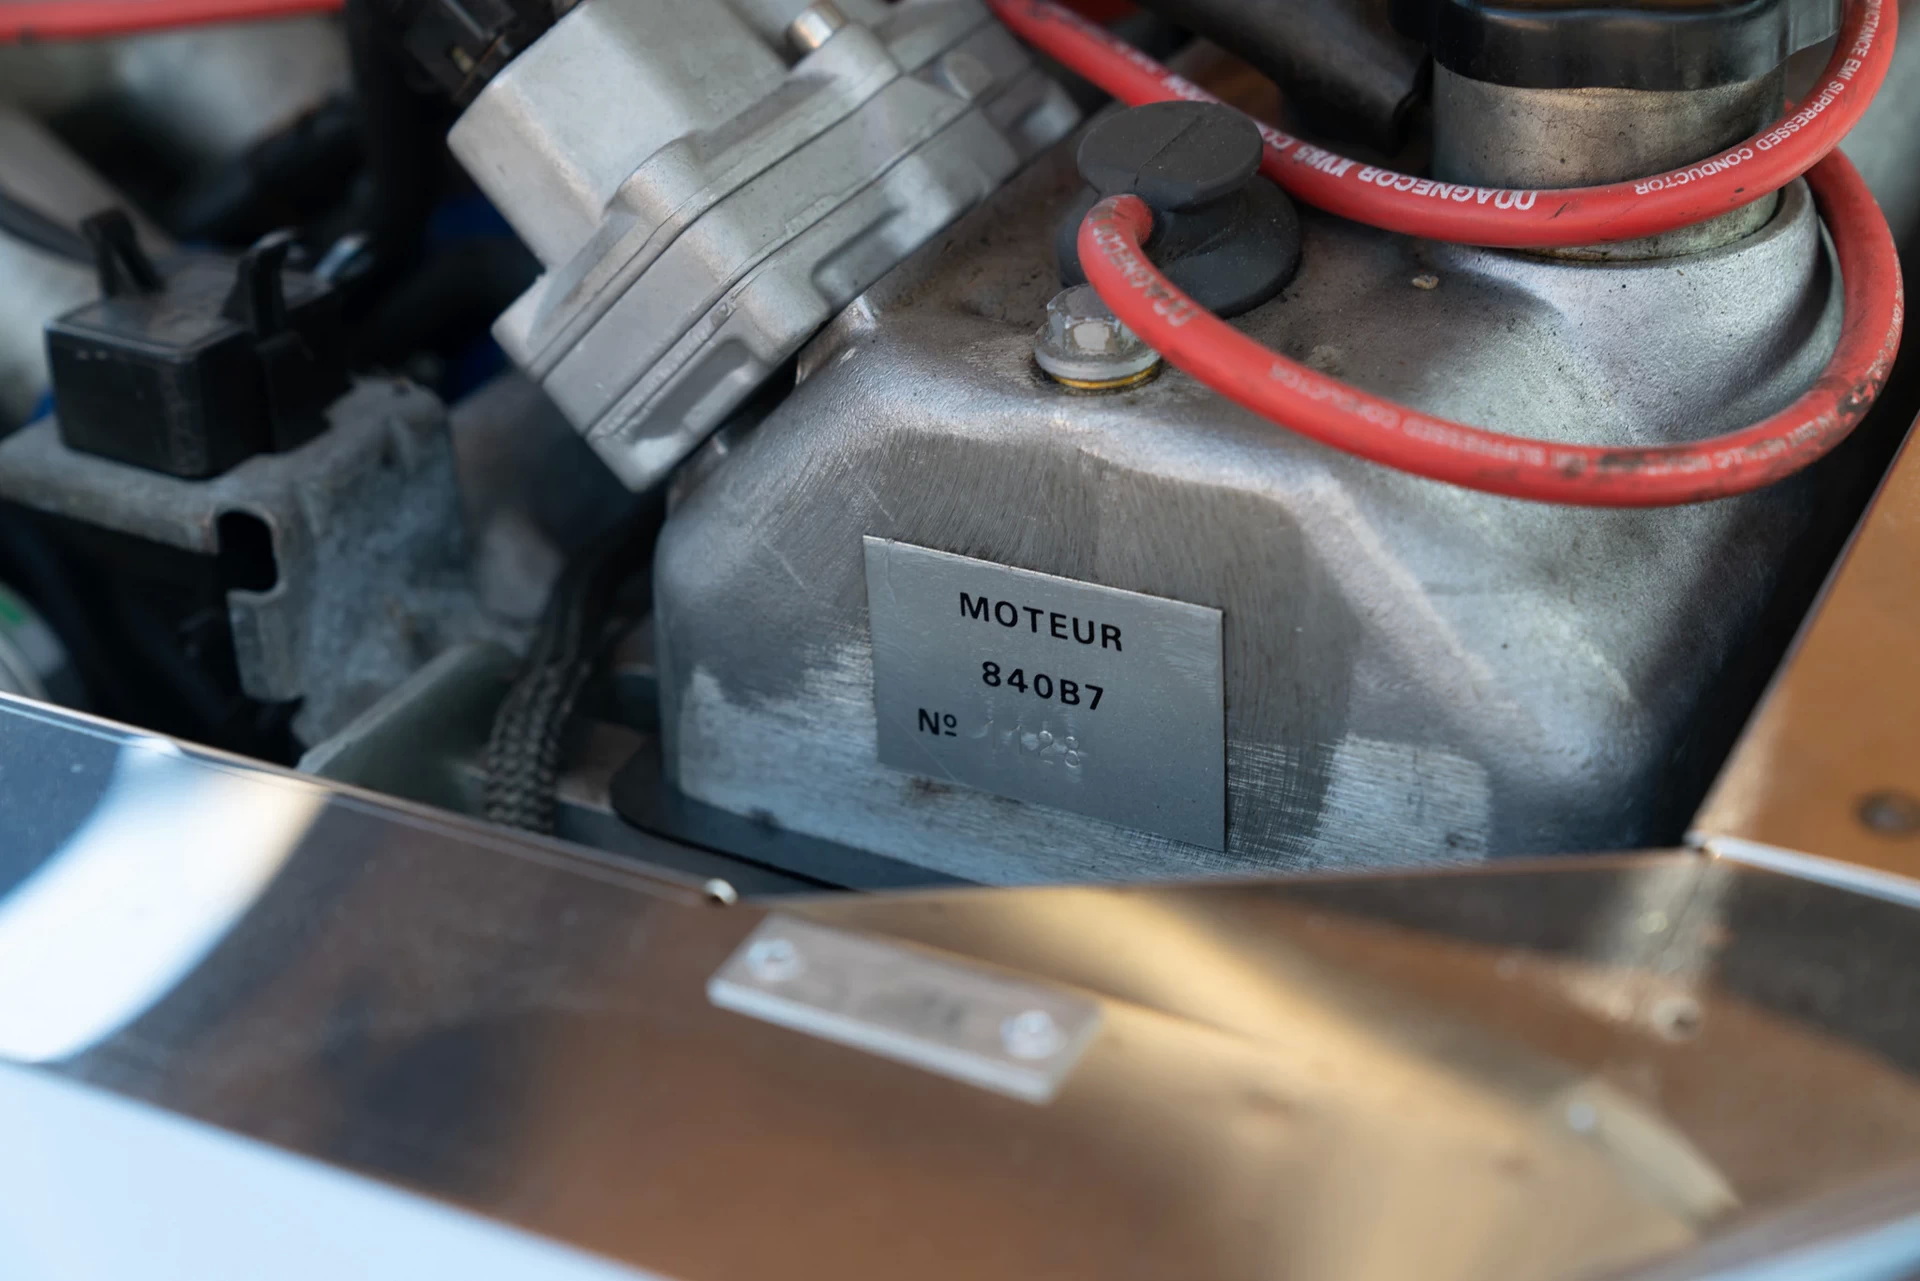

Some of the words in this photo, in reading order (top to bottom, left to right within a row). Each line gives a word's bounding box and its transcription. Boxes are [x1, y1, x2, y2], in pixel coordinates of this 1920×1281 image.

[1839, 57, 1862, 81] EMI
[1755, 80, 1845, 152] SUPPRESSED
[1357, 165, 1538, 210] MAGNECOR
[1634, 147, 1754, 195] CONDUCTOR
[959, 592, 1123, 652] MOTEUR
[982, 661, 1104, 711] 840B7
